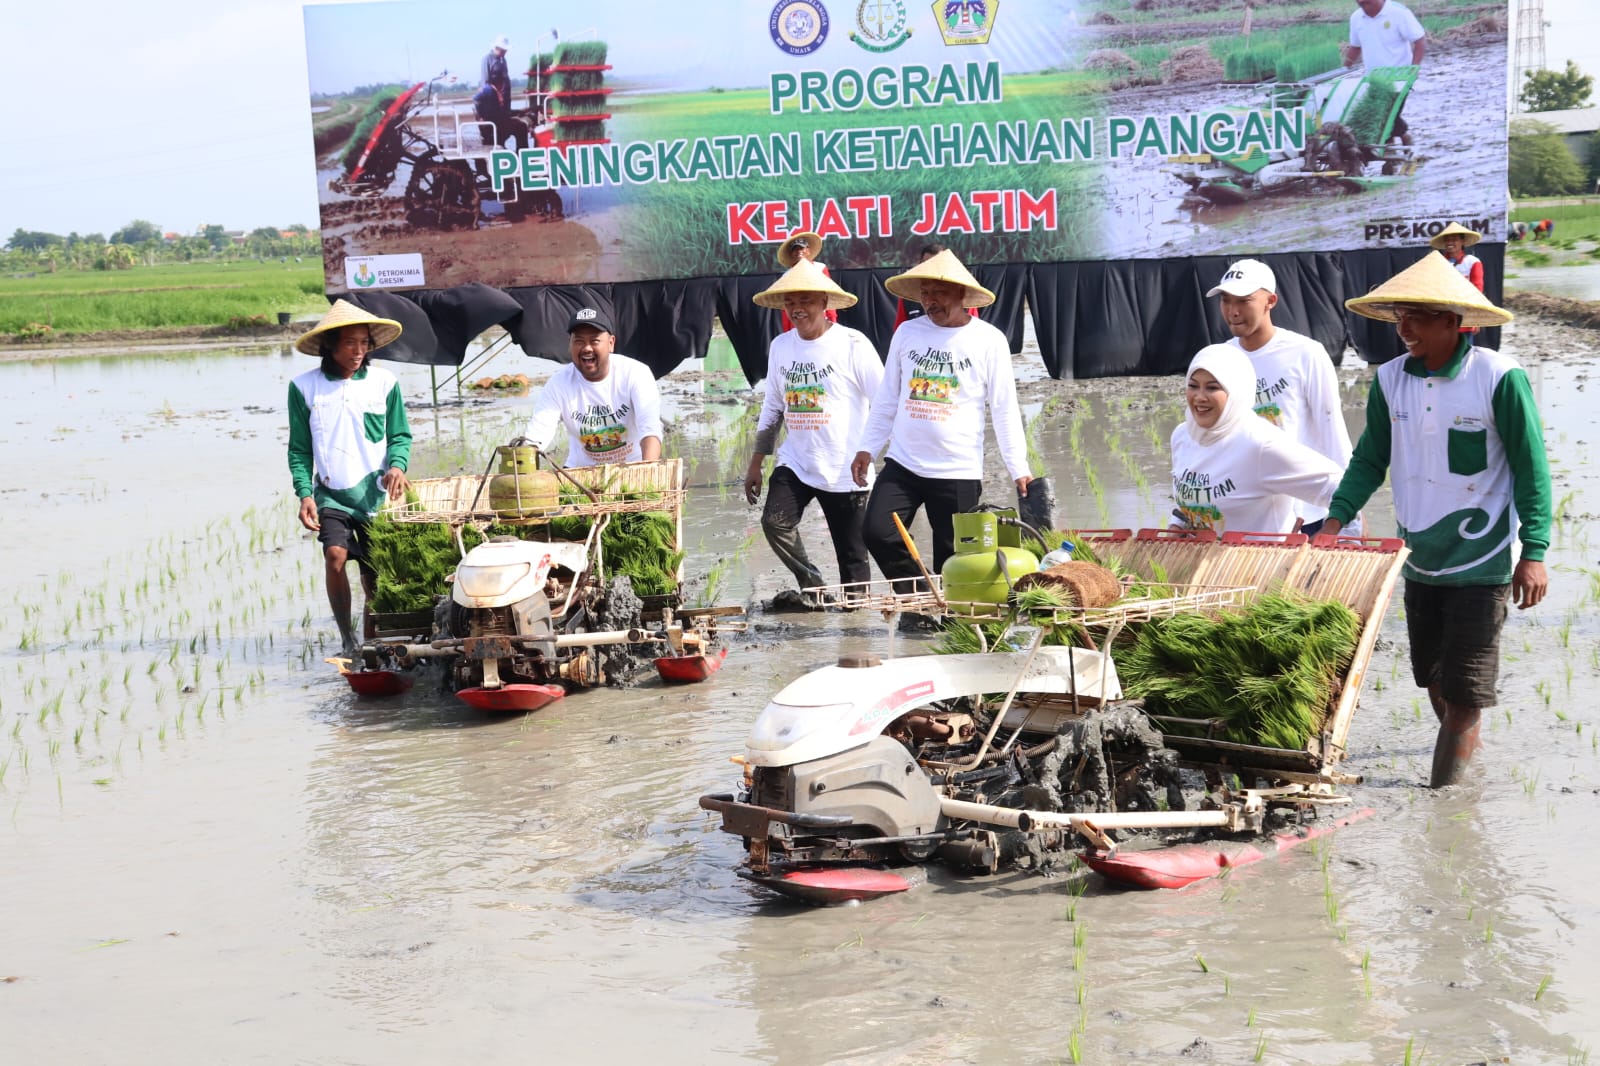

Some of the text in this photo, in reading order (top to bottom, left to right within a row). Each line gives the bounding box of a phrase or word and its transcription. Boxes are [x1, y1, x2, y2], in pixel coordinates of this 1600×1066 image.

[770, 61, 1002, 114] PROGRAM
[491, 106, 1305, 192] PENINGKATAN KETAHANAN PANGAN
[728, 188, 1058, 244] KEJATI JATIM
[378, 269, 420, 277] PETROKIMIA
[908, 350, 972, 374] SAHABAT TNI
[923, 347, 952, 361] JAKSA
[790, 361, 815, 373] JAKSA
[812, 364, 834, 383] TANI
[1263, 377, 1289, 401] TANI
[585, 404, 612, 417] JAKSA
[609, 403, 630, 424] TANI
[1204, 478, 1236, 503] TANI
